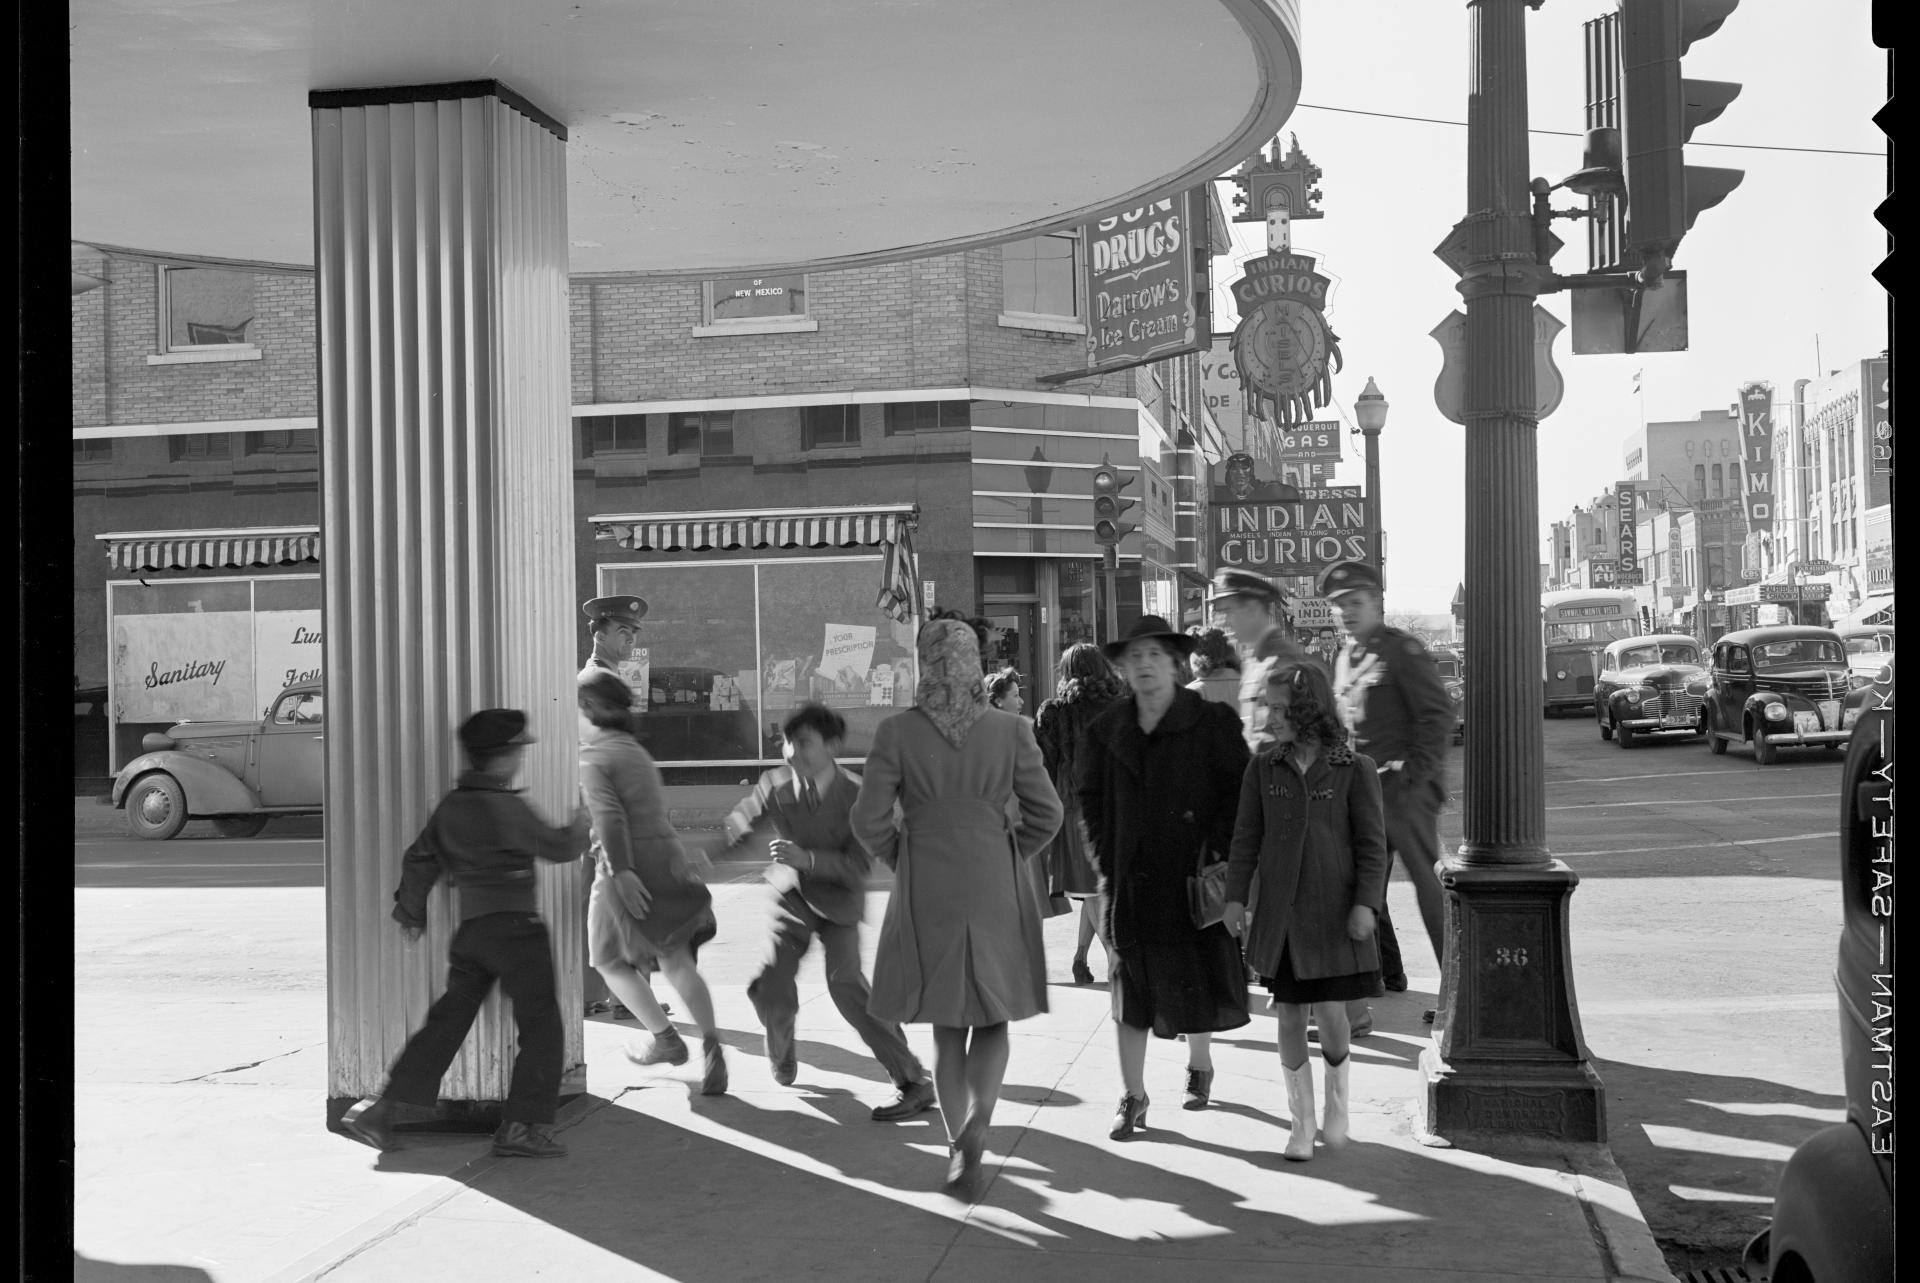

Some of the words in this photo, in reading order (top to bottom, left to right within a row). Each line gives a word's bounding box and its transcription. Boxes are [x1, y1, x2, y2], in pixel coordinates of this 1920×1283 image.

[1093, 216, 1180, 277] DRUGS
[1249, 258, 1309, 274] INDIAN
[735, 289, 751, 297] NEW
[756, 287, 783, 296] MEXICO
[1240, 274, 1324, 302] CURIOS
[1101, 327, 1123, 349] Ice
[1285, 434, 1329, 448] GAS
[1748, 412, 1770, 519] KIMO
[1221, 502, 1364, 533] INDIAN
[1269, 530, 1292, 538] INDIAN
[1300, 529, 1328, 537] TRADING
[1336, 528, 1355, 536] POST
[1619, 491, 1634, 572] SEARS
[1221, 535, 1366, 565] CURIOS
[825, 641, 874, 656] PRESCRIPTION
[833, 633, 853, 642] YOUR
[145, 659, 226, 690] Sanitary
[1496, 948, 1528, 966] 36
